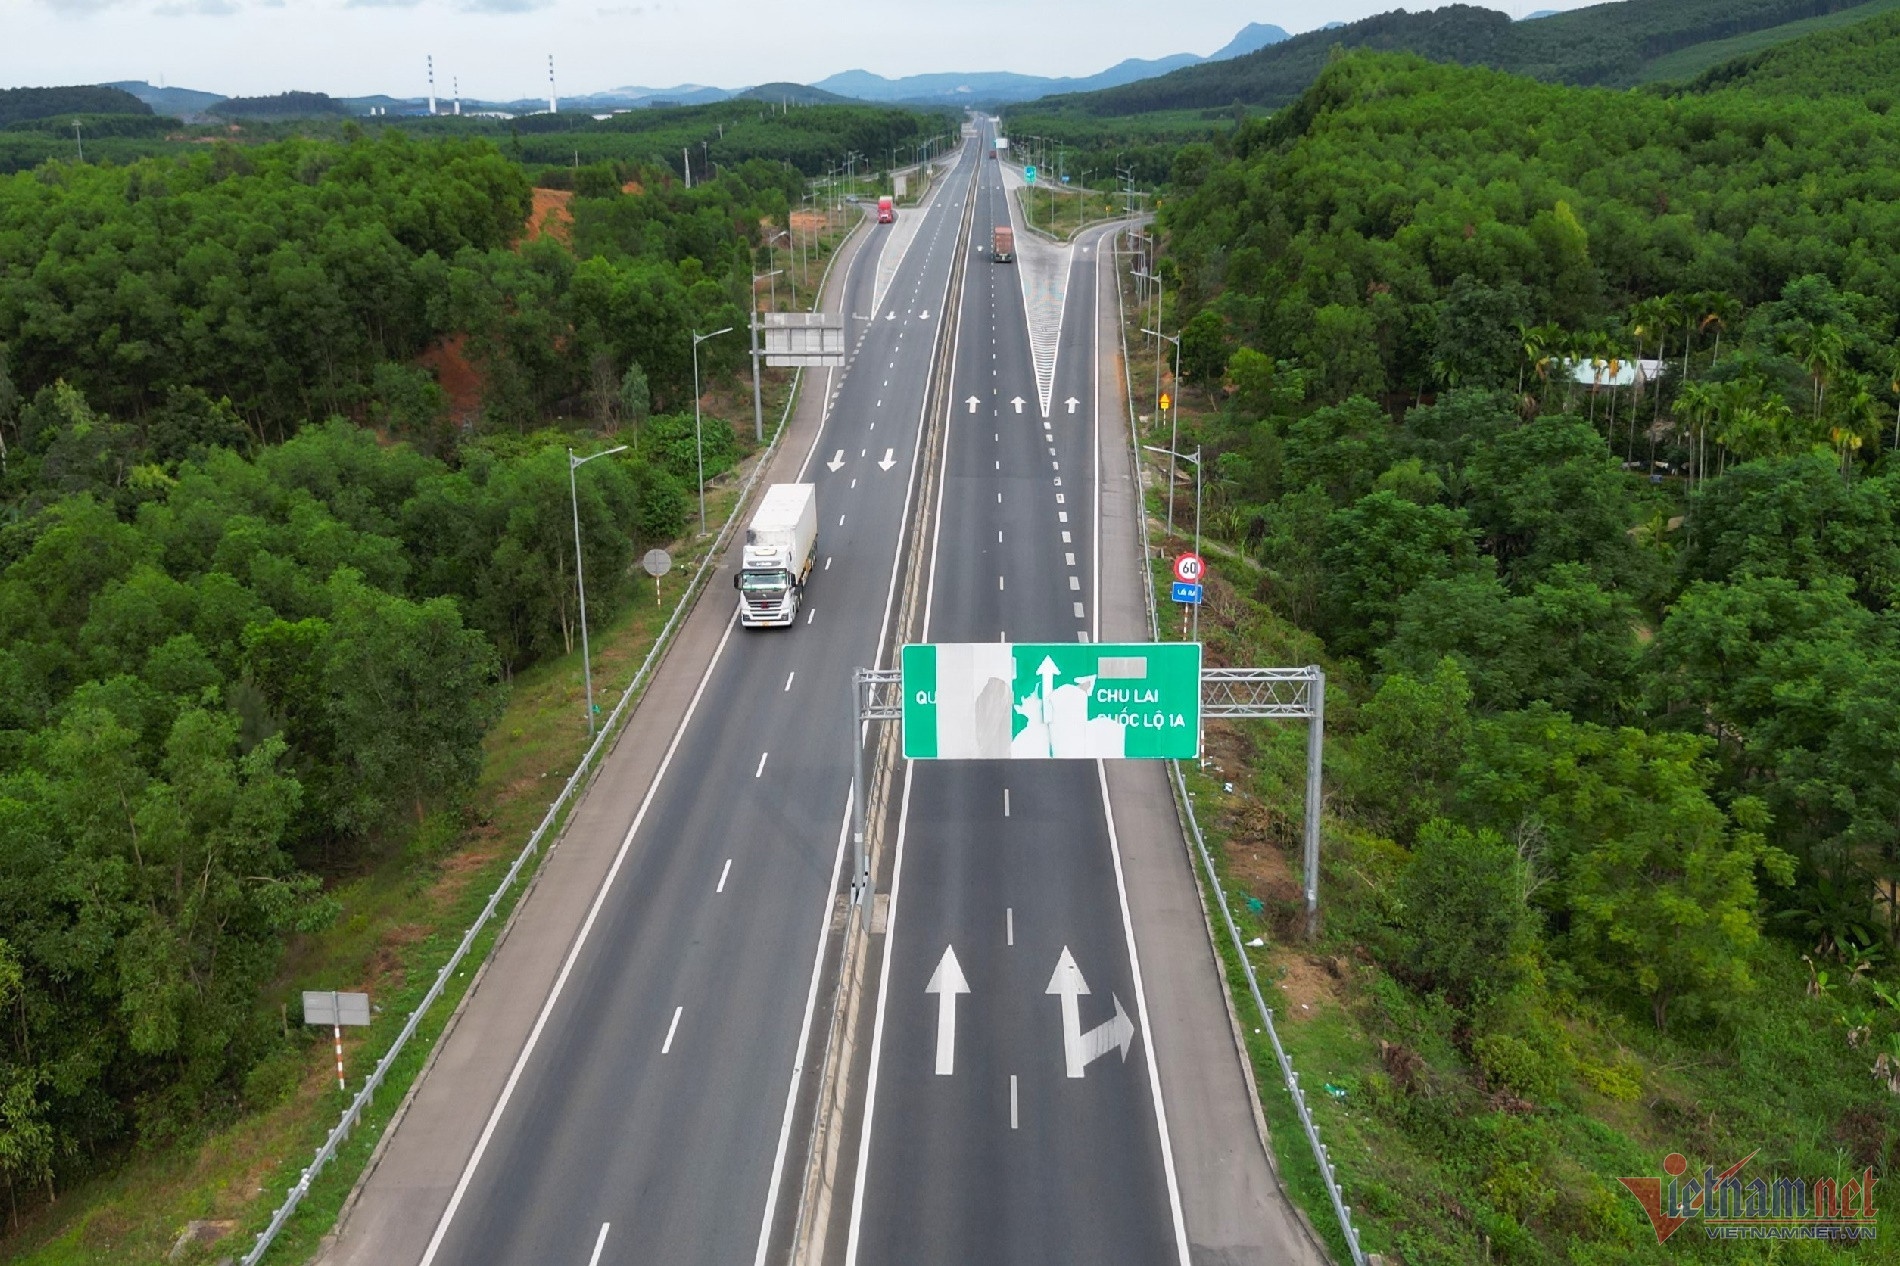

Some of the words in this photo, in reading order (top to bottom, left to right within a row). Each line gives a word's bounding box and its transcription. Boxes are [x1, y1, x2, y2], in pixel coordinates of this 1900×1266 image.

[1182, 561, 1197, 574] 60
[1097, 688, 1130, 702] CHU
[1134, 688, 1159, 702] LAI
[1097, 706, 1140, 728] ỐC
[1143, 709, 1165, 730] LỘ
[1168, 713, 1186, 728] 1A
